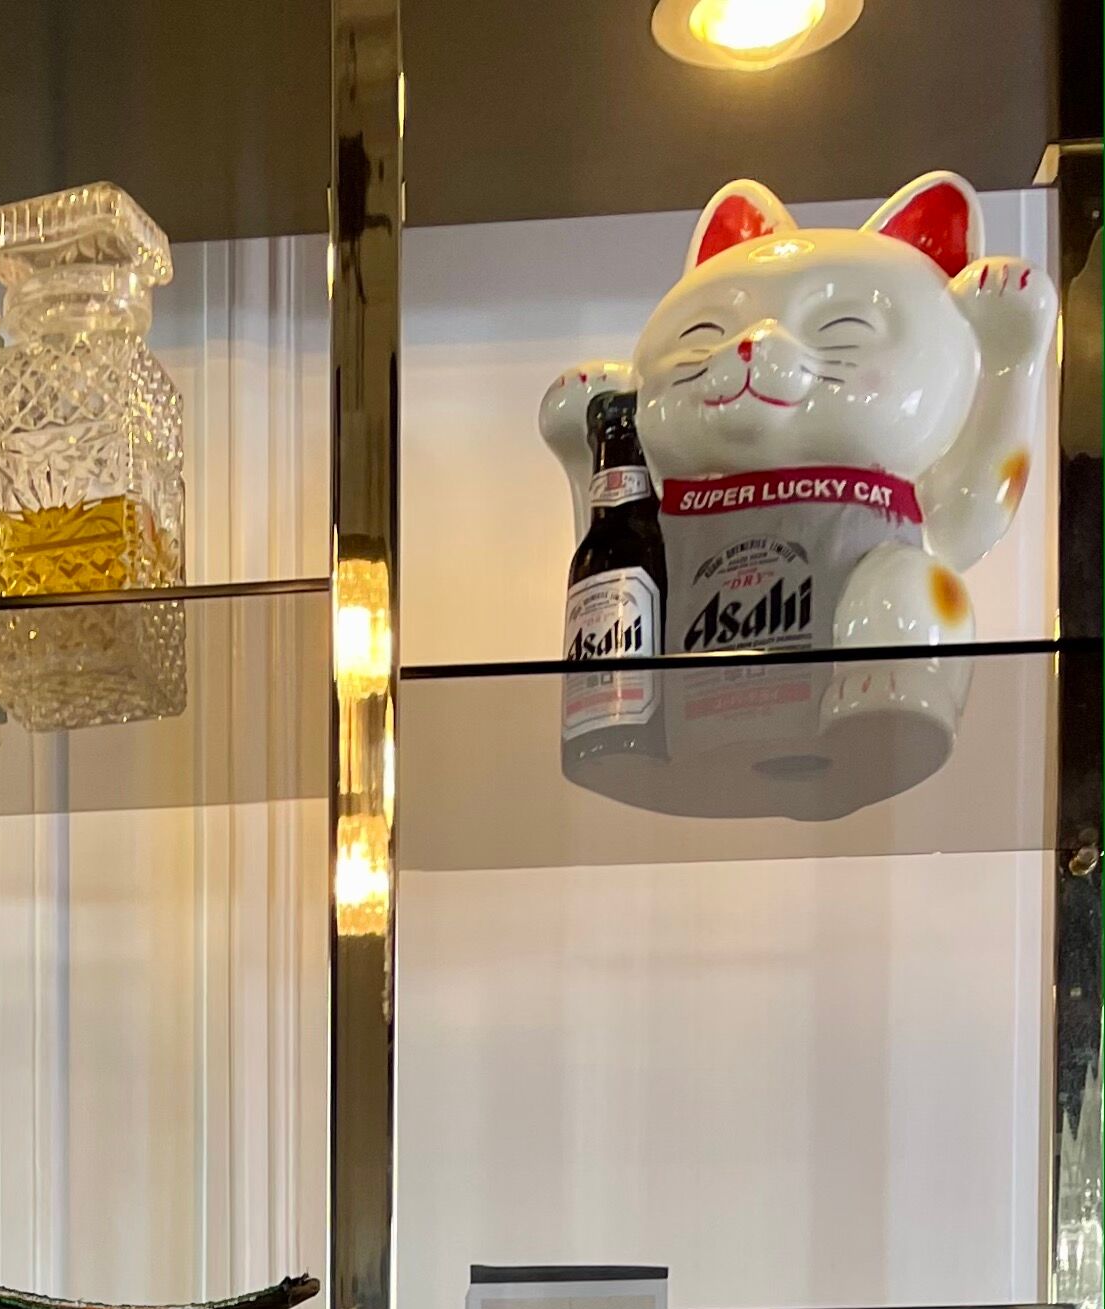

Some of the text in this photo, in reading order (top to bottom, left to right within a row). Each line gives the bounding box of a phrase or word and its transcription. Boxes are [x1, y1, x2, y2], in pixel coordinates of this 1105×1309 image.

[679, 479, 893, 510] SUPER LUCKY CAT
[684, 574, 813, 652] Asahi
[567, 614, 642, 661] Asahi
